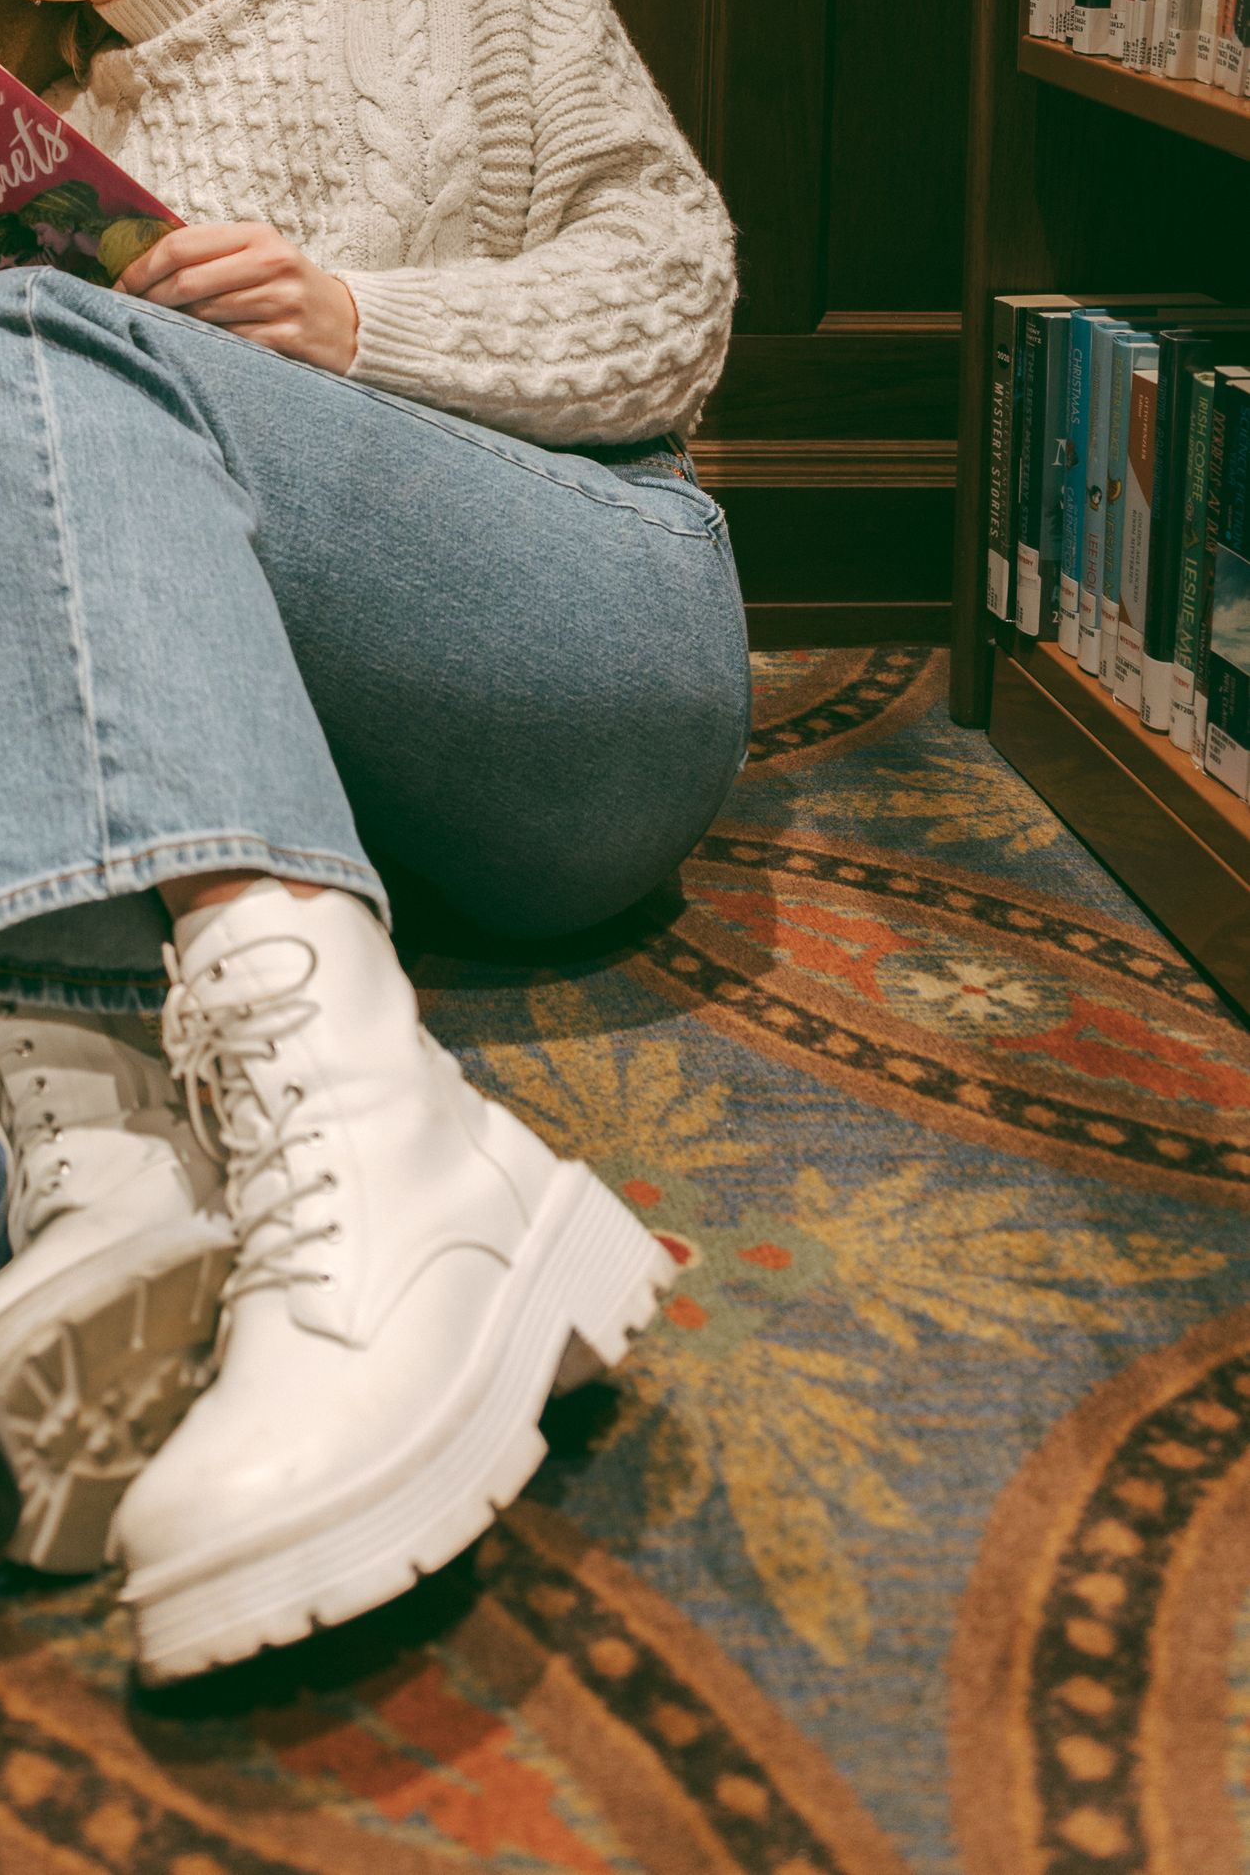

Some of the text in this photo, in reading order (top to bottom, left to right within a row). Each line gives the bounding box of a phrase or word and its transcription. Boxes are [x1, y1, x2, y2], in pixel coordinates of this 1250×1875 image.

[1070, 347, 1083, 425] CHRISTMAS
[989, 380, 1005, 539] MYSTERY STORIES
[1022, 428, 1032, 499] MYSTERY
[1191, 395, 1209, 502] IRISH COFFEE
[1088, 532, 1099, 557] LEE
[1129, 537, 1137, 584] MYSTERIES
[1182, 557, 1199, 624] LESLIE
